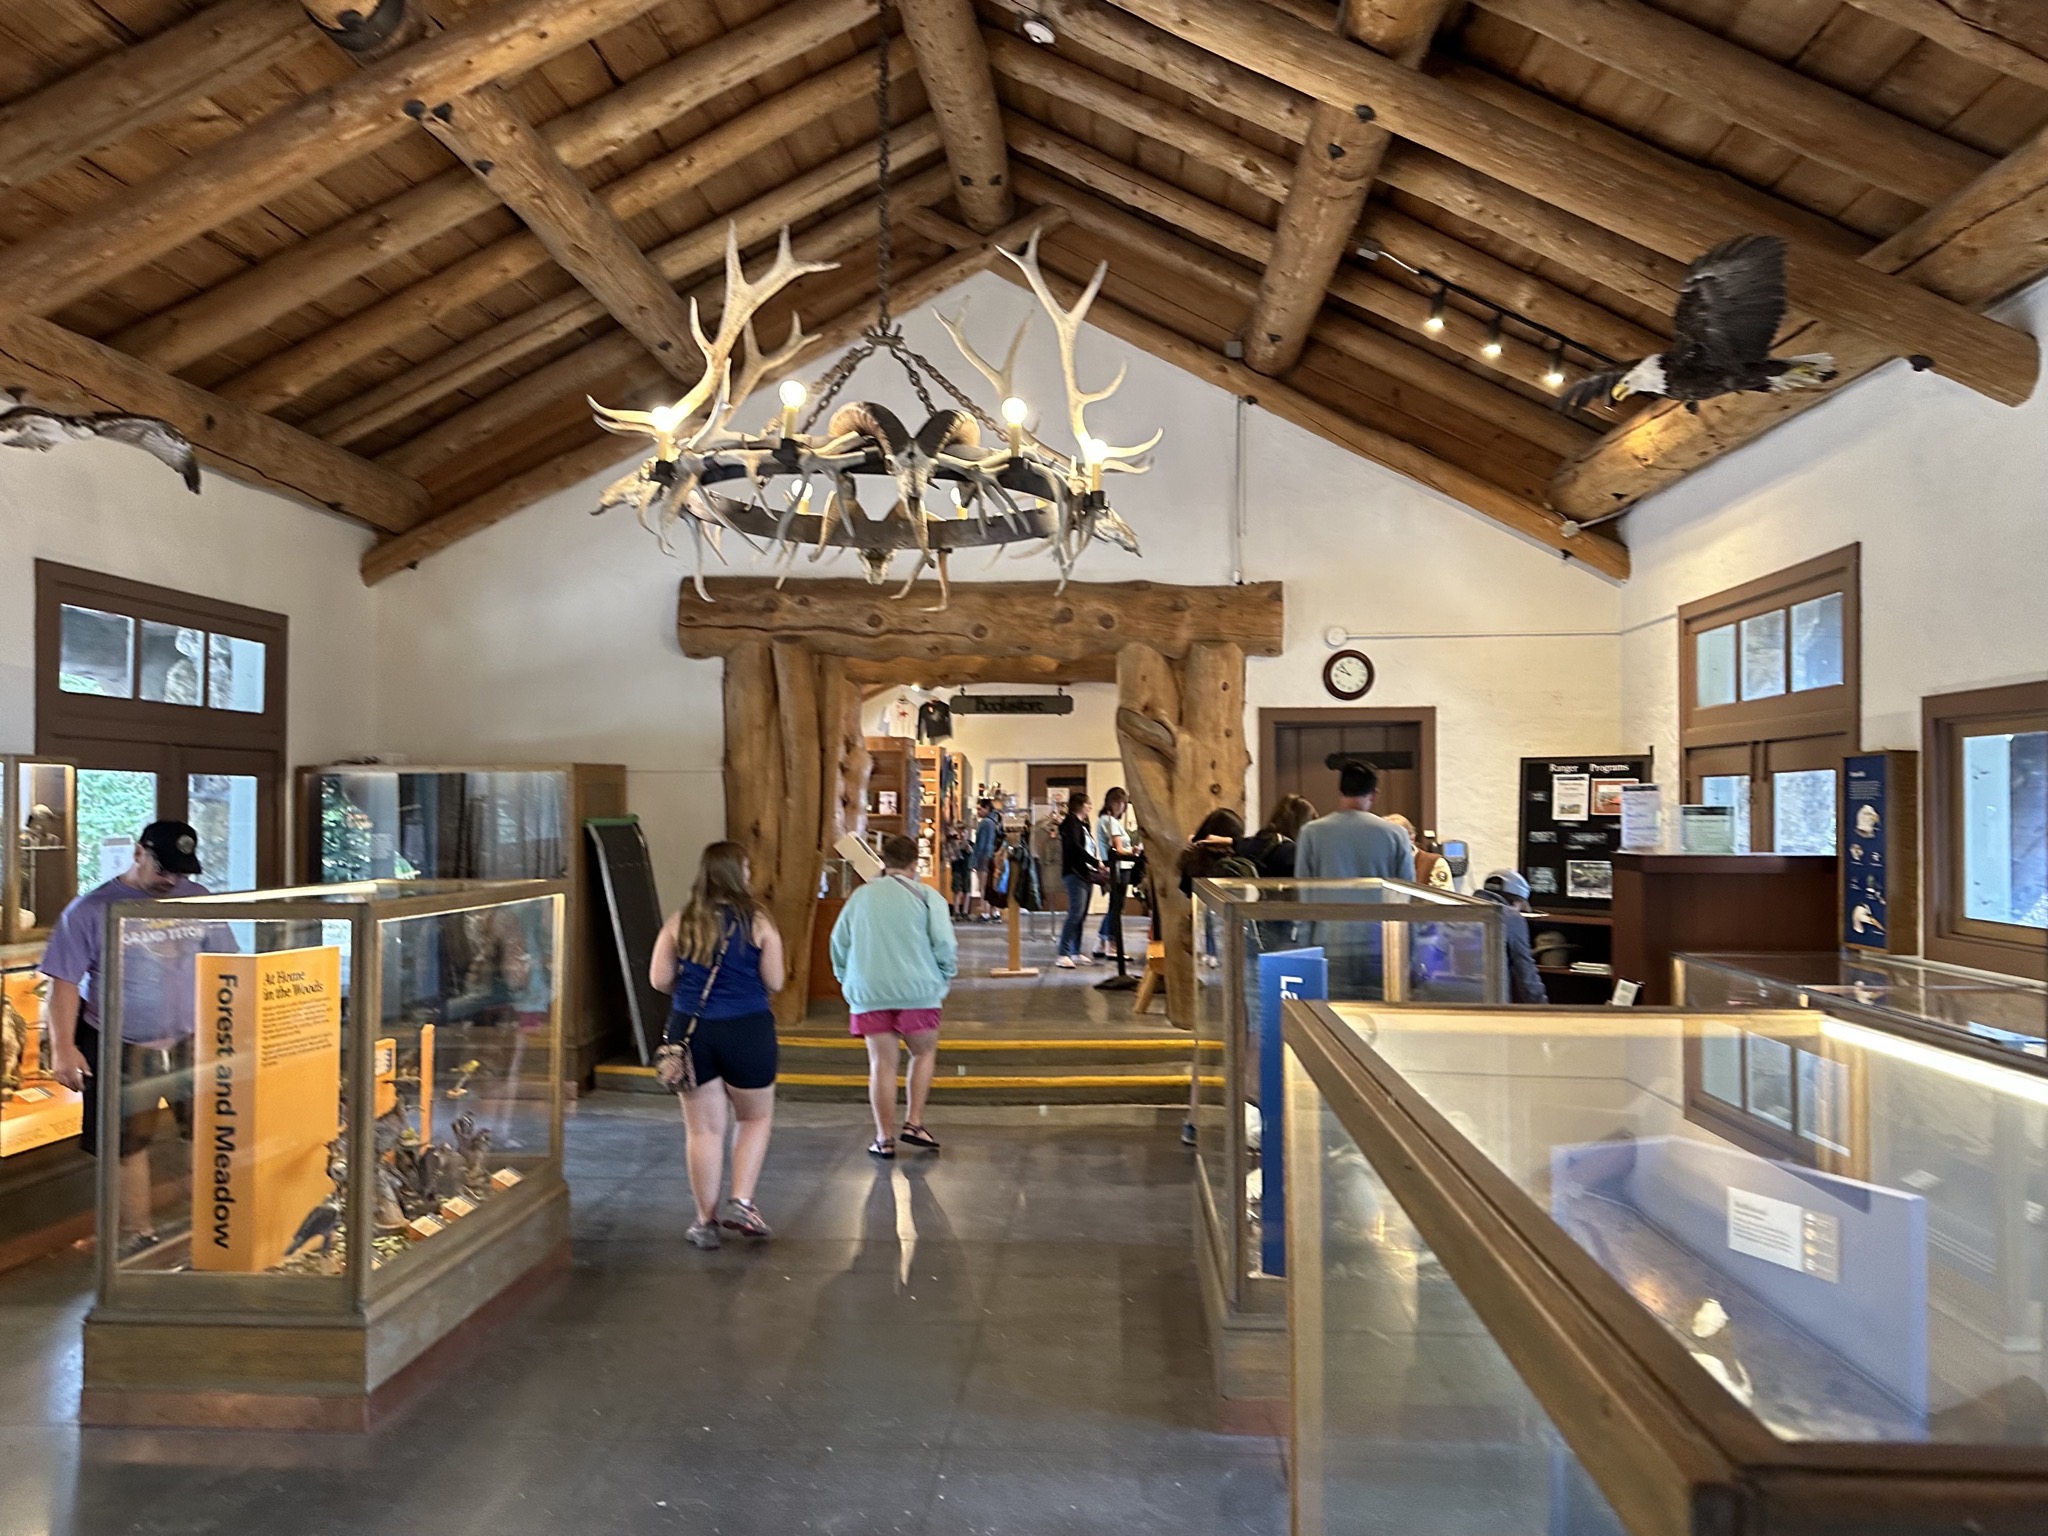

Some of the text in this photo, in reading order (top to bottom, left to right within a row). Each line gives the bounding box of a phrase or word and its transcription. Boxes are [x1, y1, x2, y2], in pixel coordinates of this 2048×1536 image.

[1549, 764, 1630, 774] Ranger Programs
[277, 971, 305, 983] Home
[276, 986, 291, 998] the
[214, 973, 238, 1249] Forest and Meadow
